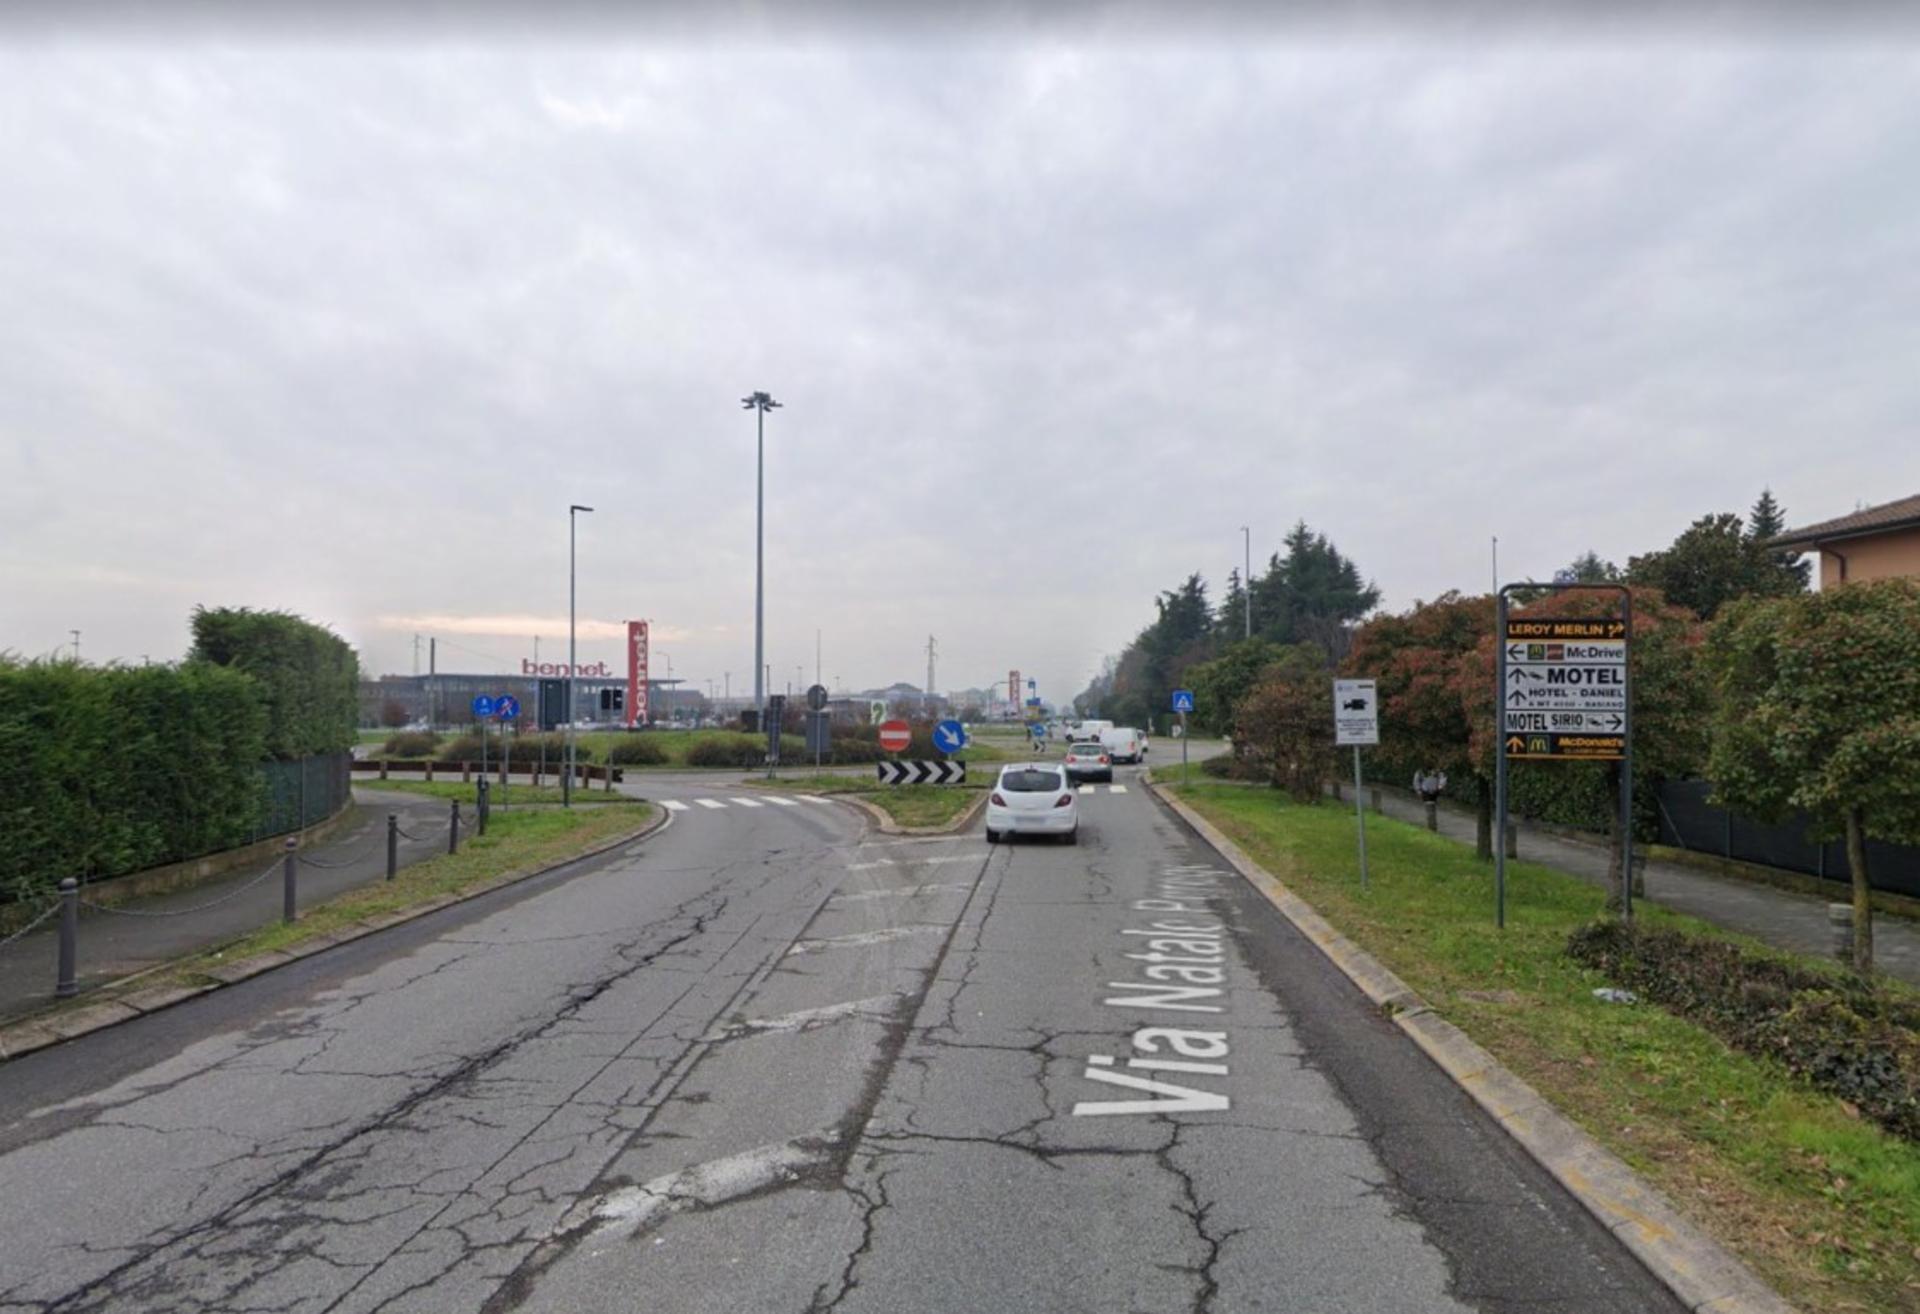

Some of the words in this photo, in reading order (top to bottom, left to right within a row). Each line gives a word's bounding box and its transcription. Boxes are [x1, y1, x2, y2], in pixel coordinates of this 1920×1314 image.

[1508, 624, 1551, 635] LEROY
[1554, 624, 1603, 635] MERLIN
[1567, 646, 1623, 658] McDrive
[522, 658, 612, 677] bennet
[1547, 668, 1623, 684] MOTEL
[1529, 688, 1568, 698] HOTEL
[1580, 688, 1623, 698] DANIEL
[1507, 714, 1548, 730] MOTEL
[1551, 714, 1583, 726] SIRIO
